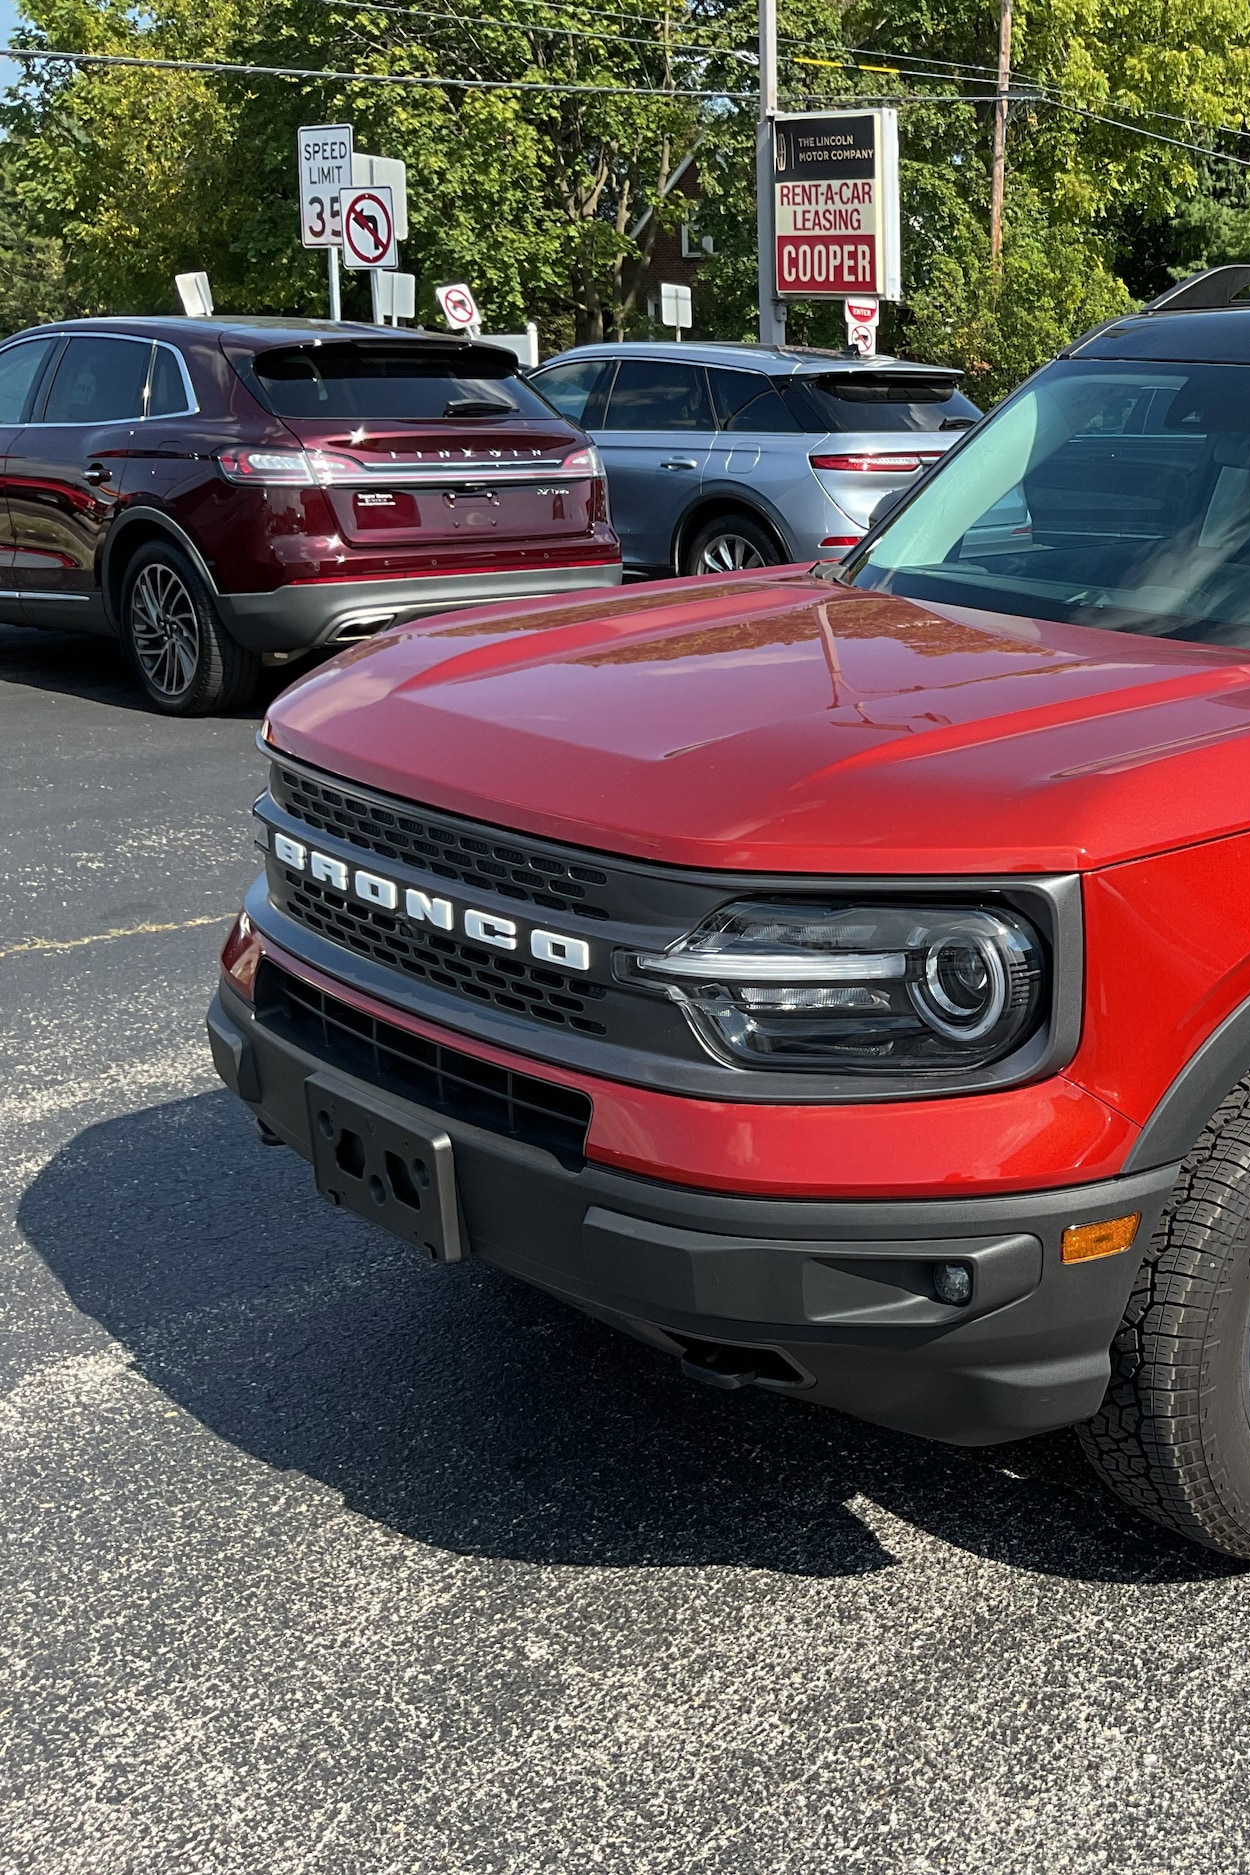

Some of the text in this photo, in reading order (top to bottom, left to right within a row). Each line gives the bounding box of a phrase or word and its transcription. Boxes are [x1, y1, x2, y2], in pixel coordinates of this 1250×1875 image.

[304, 141, 347, 161] SPEED
[798, 135, 854, 148] THE LINCOLN
[799, 149, 874, 162] MOTOR COMPANY
[309, 165, 343, 185] LIMIT
[780, 182, 873, 206] RENT-A-CAR
[308, 196, 341, 237] 35
[793, 208, 861, 232] LEASING
[782, 244, 871, 282] COOPER
[274, 832, 590, 971] BRONCO
